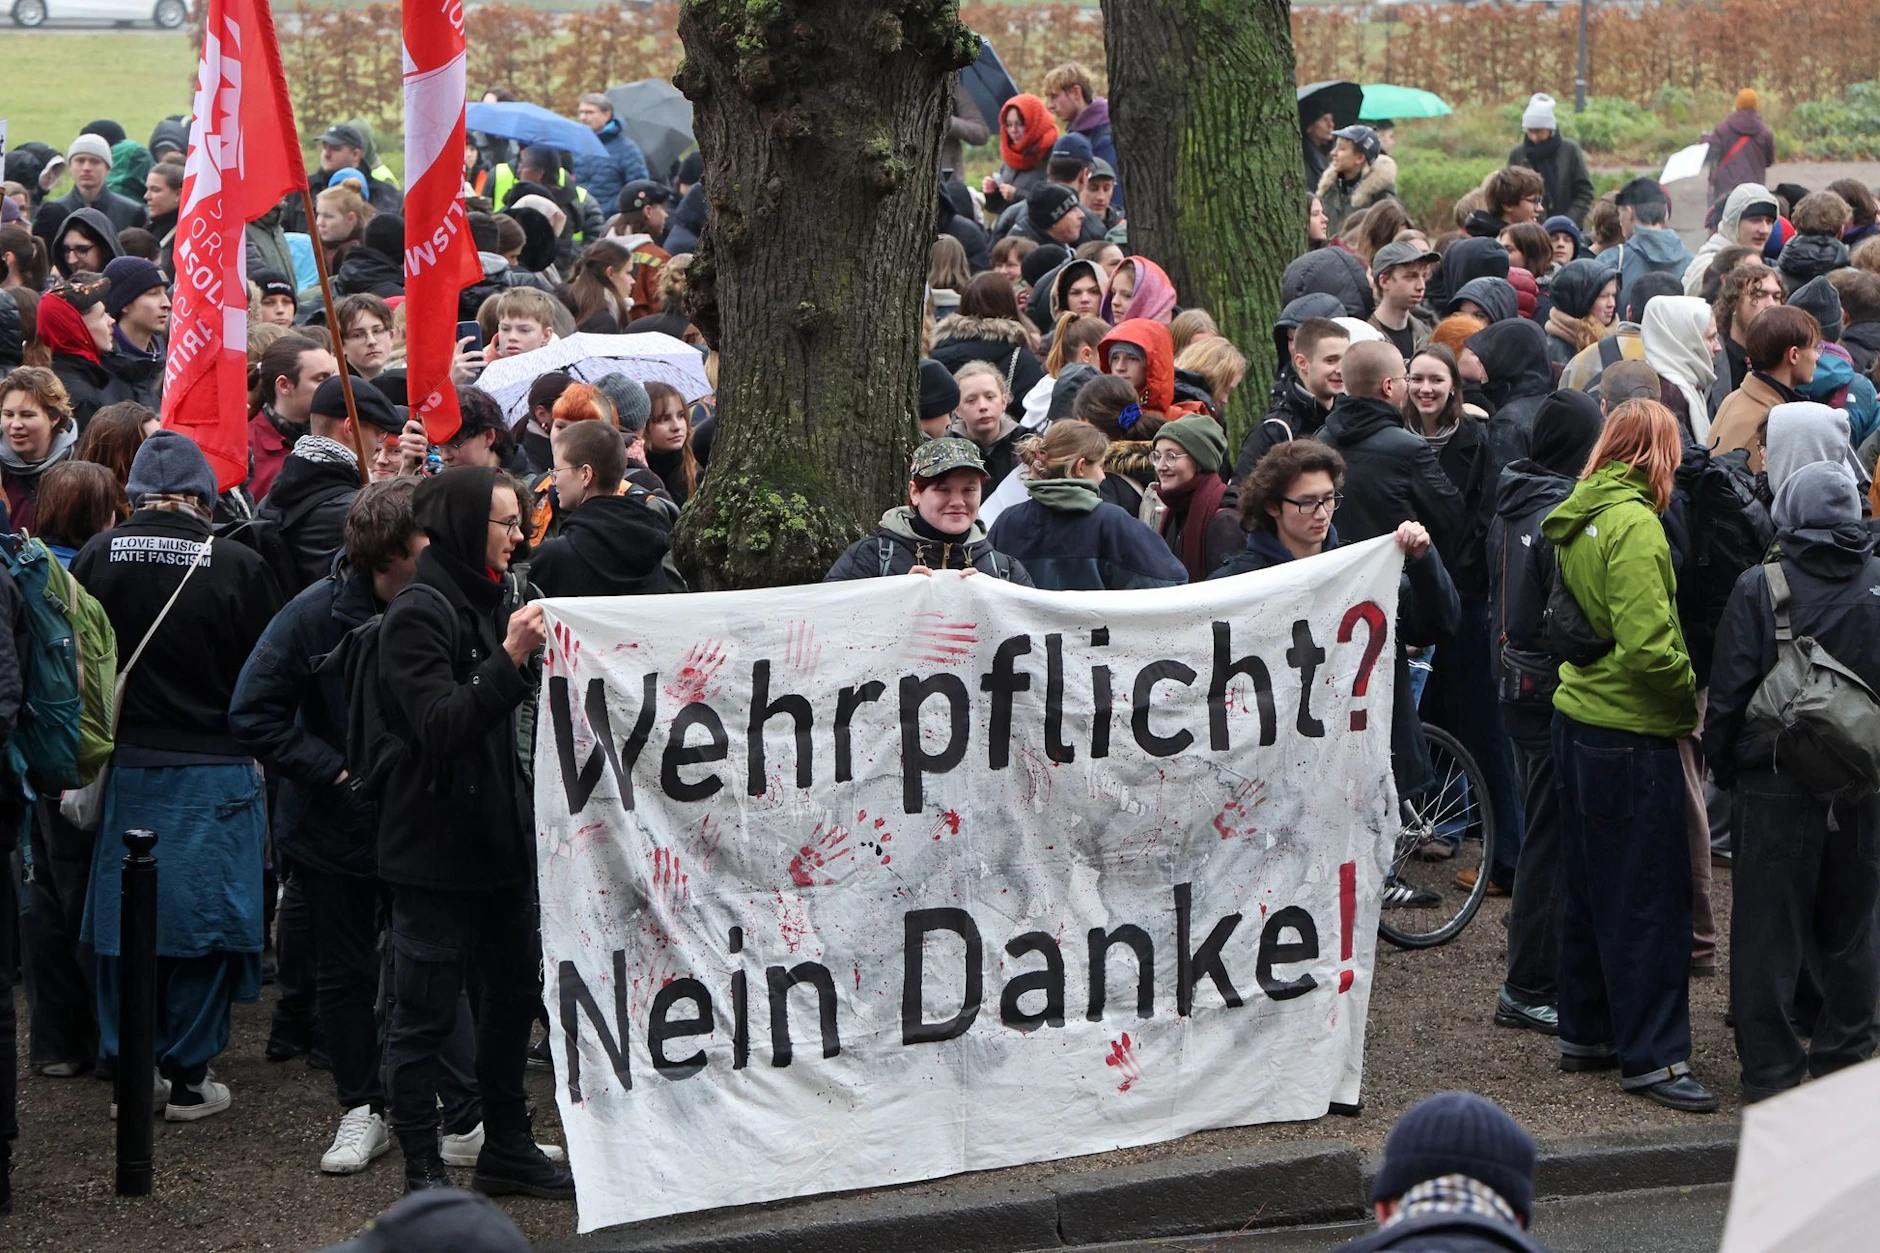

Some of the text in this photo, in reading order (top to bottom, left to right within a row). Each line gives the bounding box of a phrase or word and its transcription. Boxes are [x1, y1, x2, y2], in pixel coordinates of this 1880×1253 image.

[404, 164, 467, 278] ALISM
[110, 551, 211, 568] HATE FASCISM
[120, 538, 202, 553] LOVE MUSIC
[549, 600, 1388, 815] Wehrpflicht?
[558, 861, 1356, 1103] Nein Danke!
